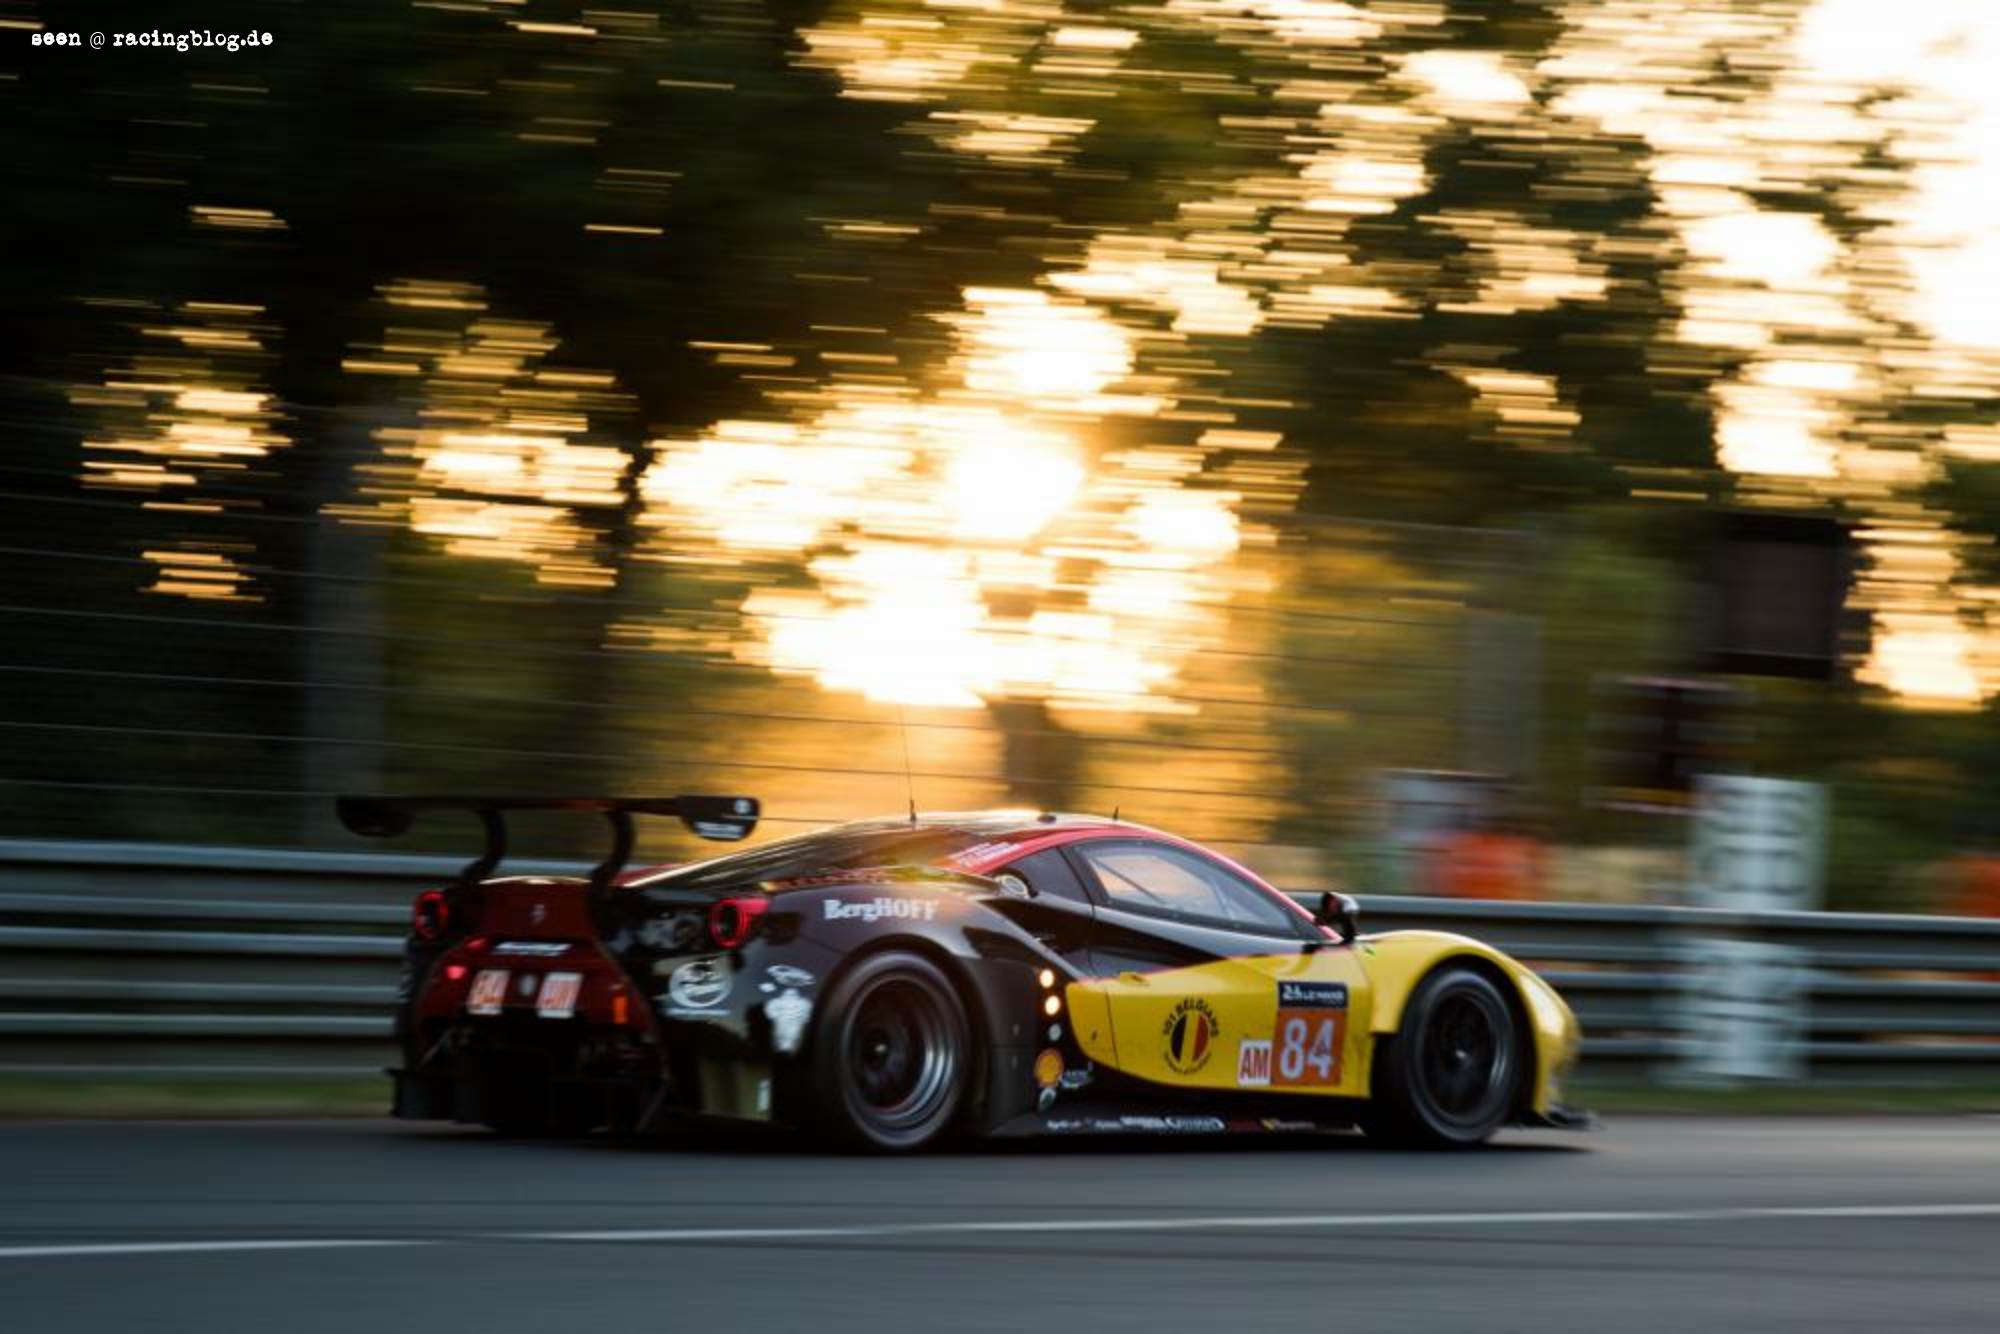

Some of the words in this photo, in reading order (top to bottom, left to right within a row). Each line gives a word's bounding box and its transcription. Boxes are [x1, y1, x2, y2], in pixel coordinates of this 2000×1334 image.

[823, 897, 939, 922] BergHOFF
[1239, 1046, 1269, 1080] AM
[1280, 1018, 1335, 1080] 84
